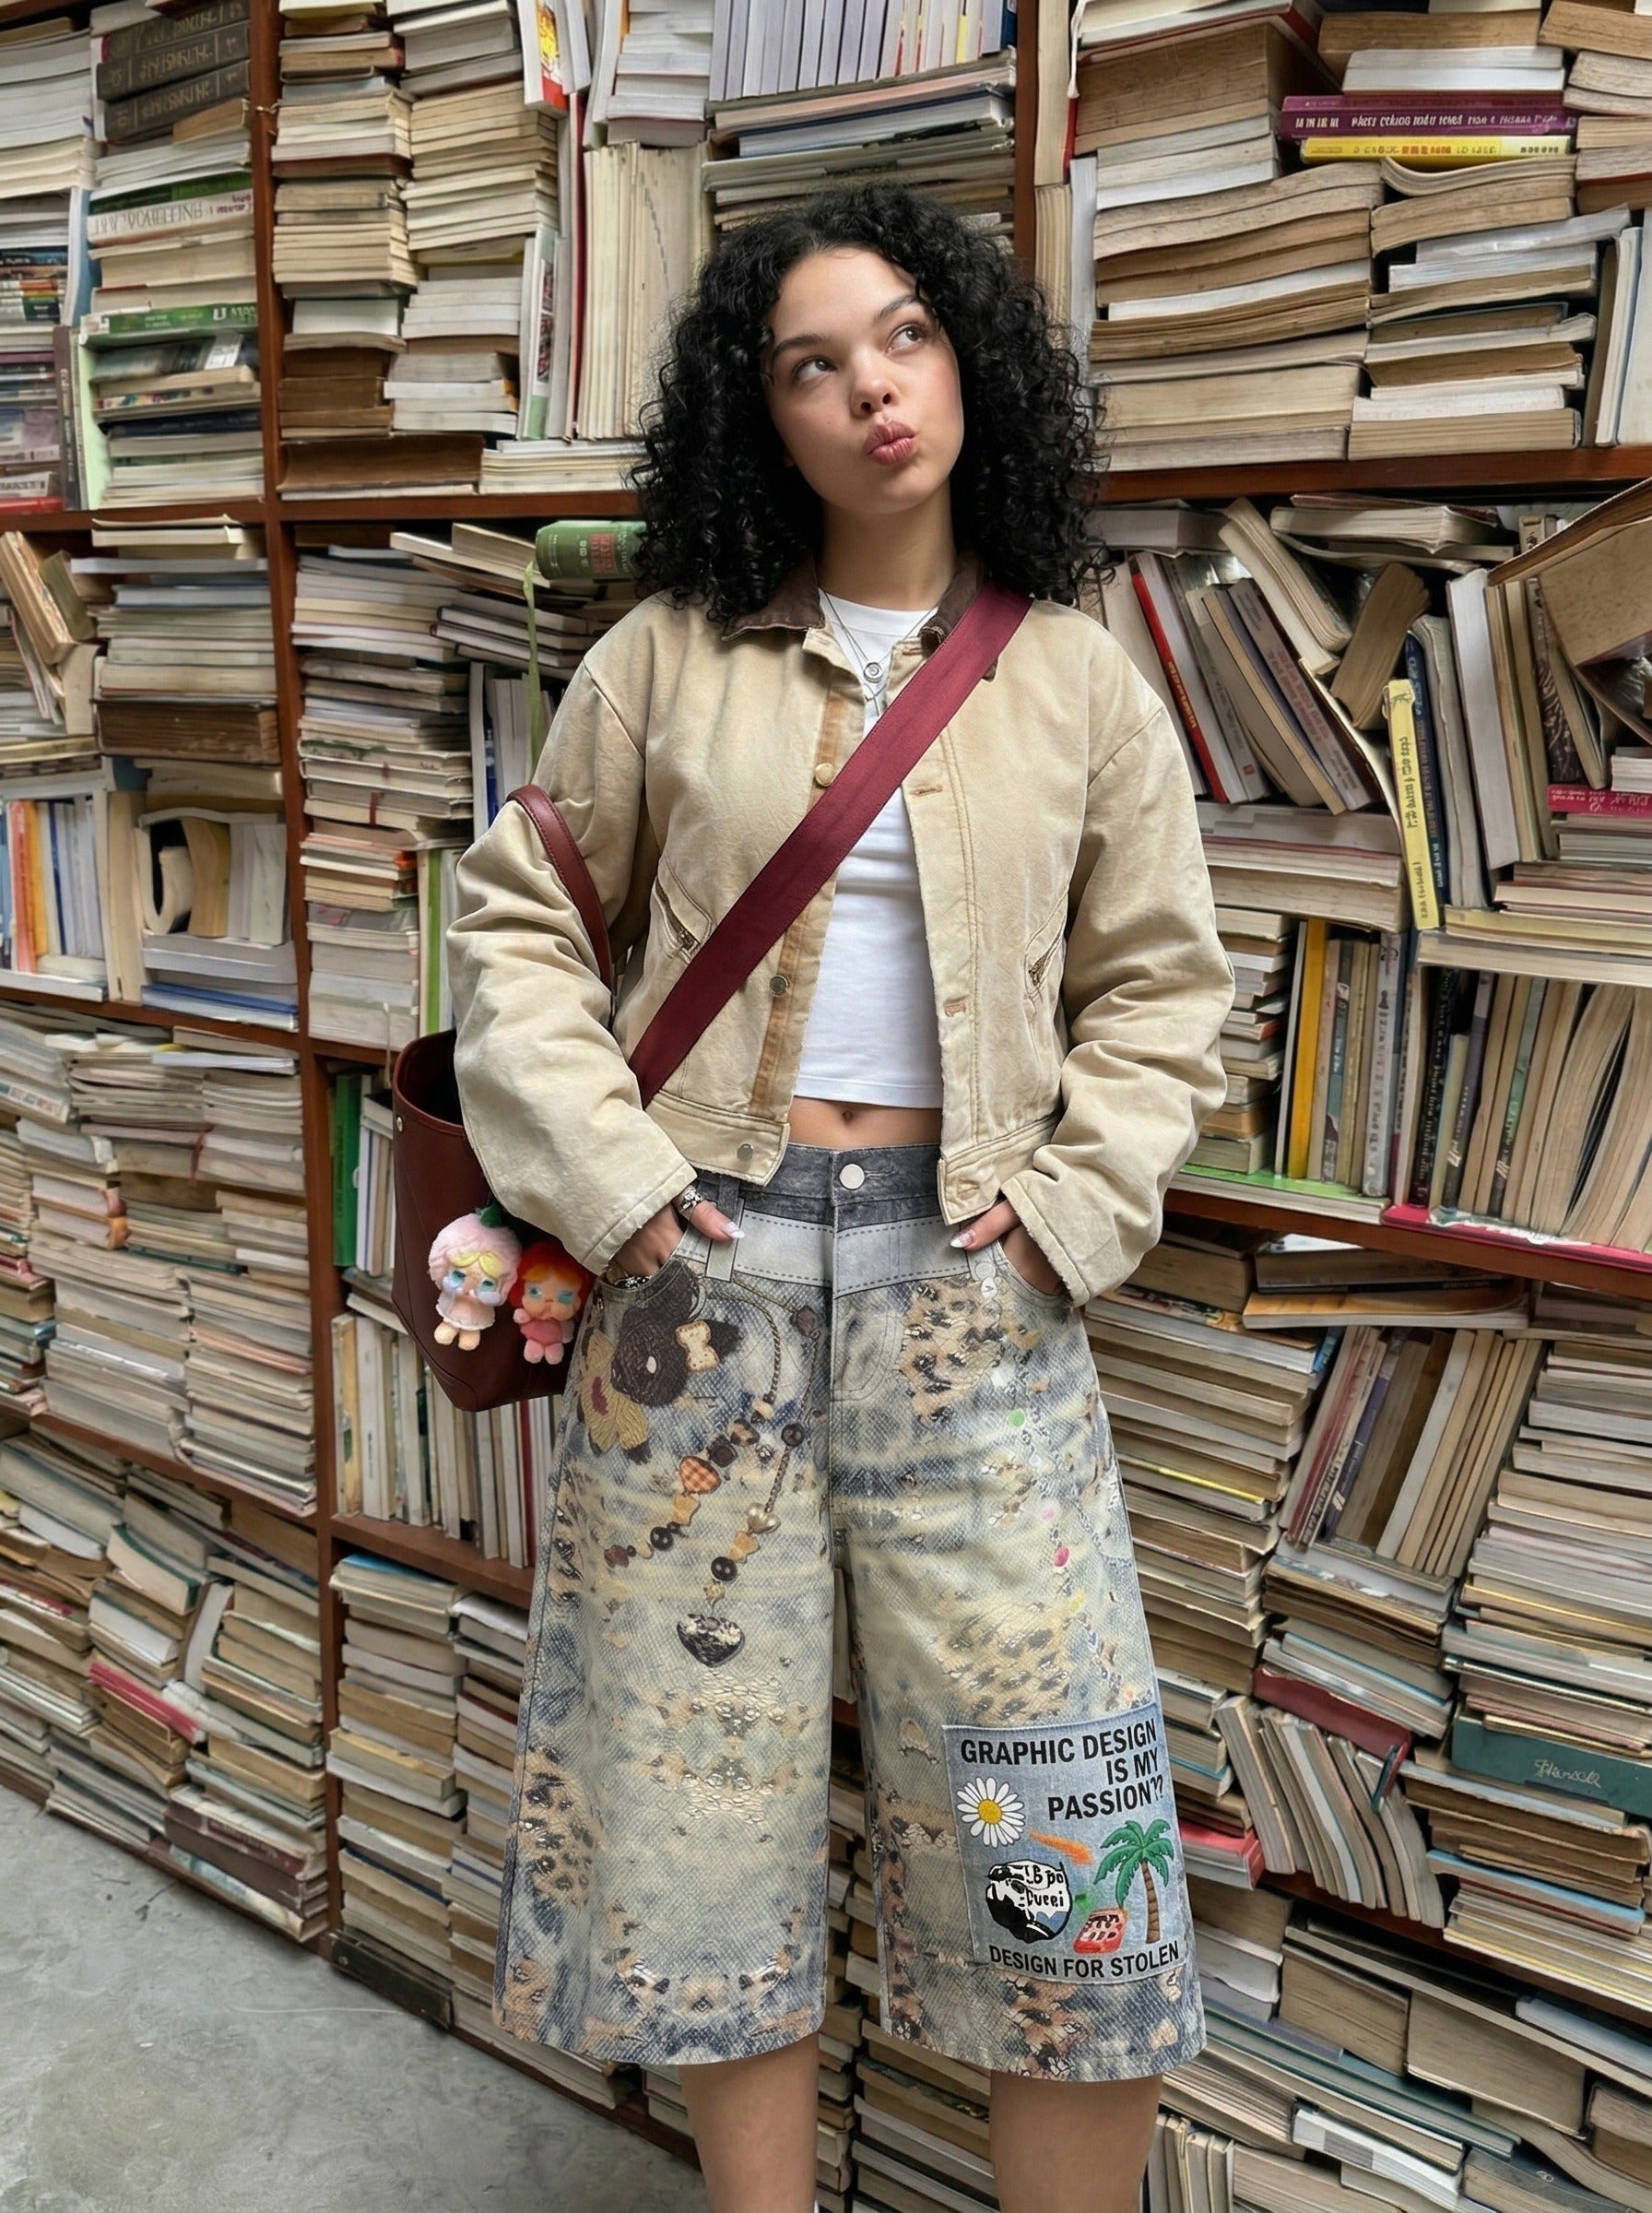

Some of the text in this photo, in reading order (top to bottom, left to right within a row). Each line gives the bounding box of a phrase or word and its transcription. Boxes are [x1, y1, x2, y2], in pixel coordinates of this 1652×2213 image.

[961, 1718, 1157, 1766] GRAPHIC DESIGN
[1106, 1746, 1159, 1785] IS MY
[989, 1940, 1179, 1978] DESIGN FOR STOLEN
